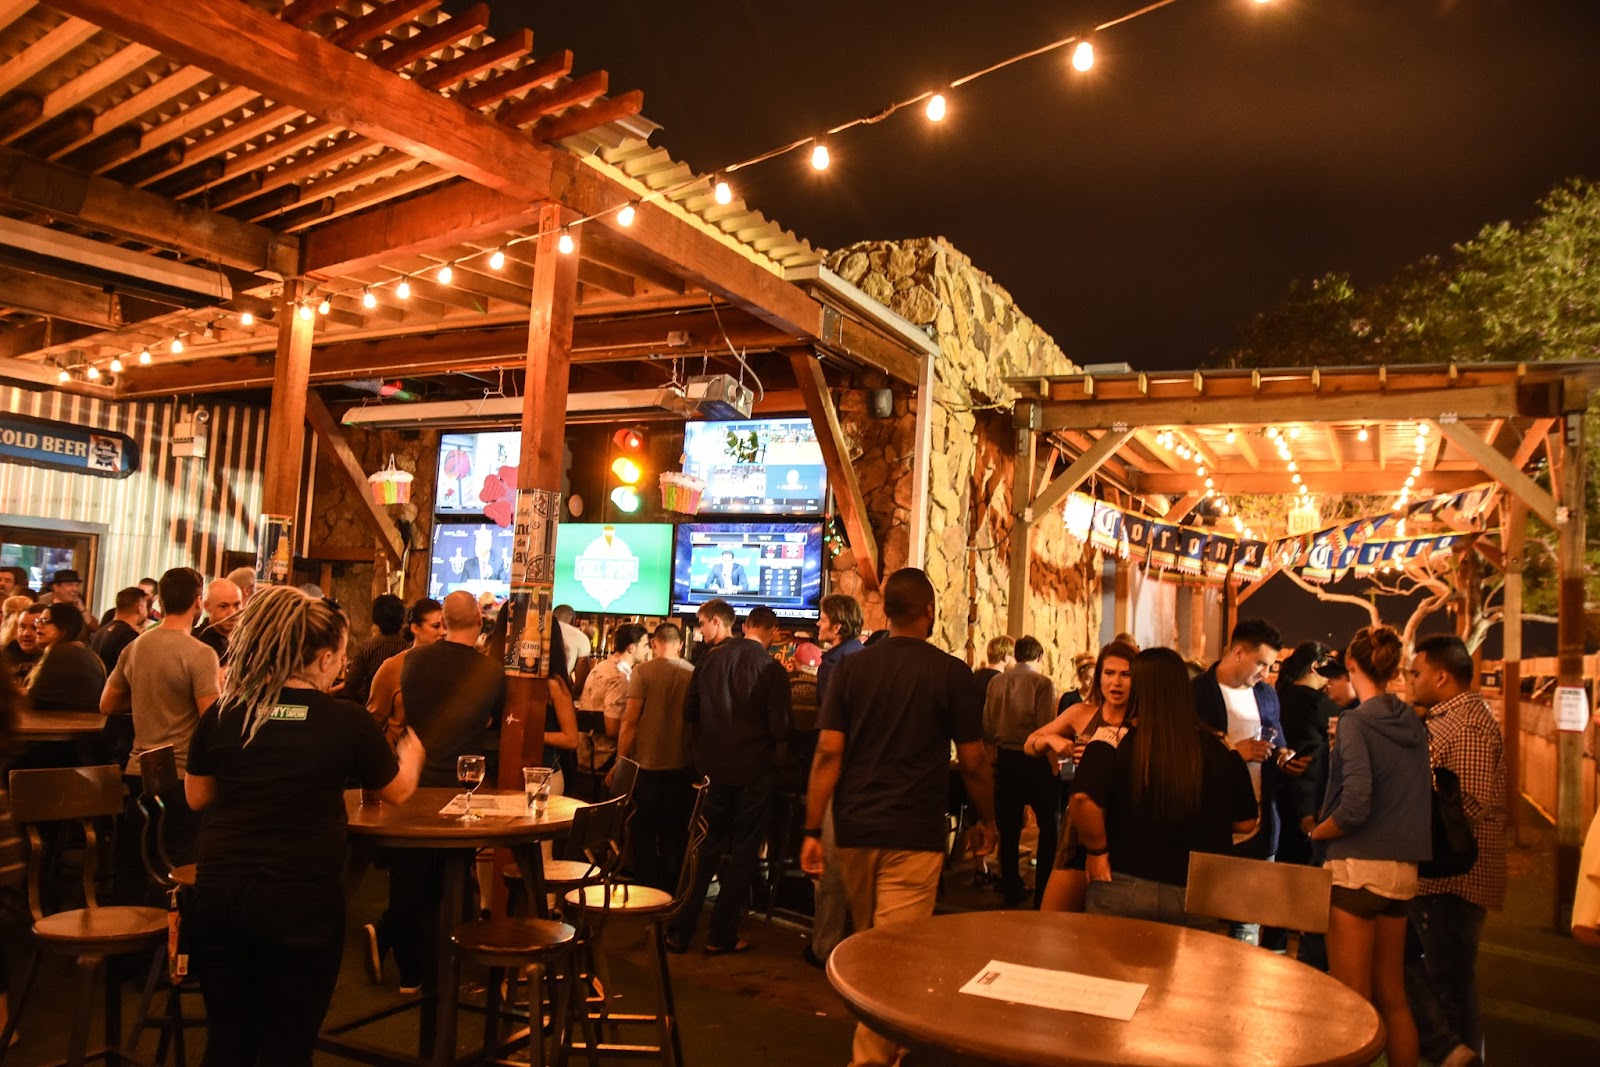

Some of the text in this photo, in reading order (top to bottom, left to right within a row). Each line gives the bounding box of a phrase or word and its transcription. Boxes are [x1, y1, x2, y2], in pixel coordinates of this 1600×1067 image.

[0, 428, 38, 449] OLD
[42, 435, 87, 458] BEER
[1101, 508, 1257, 564] Corona
